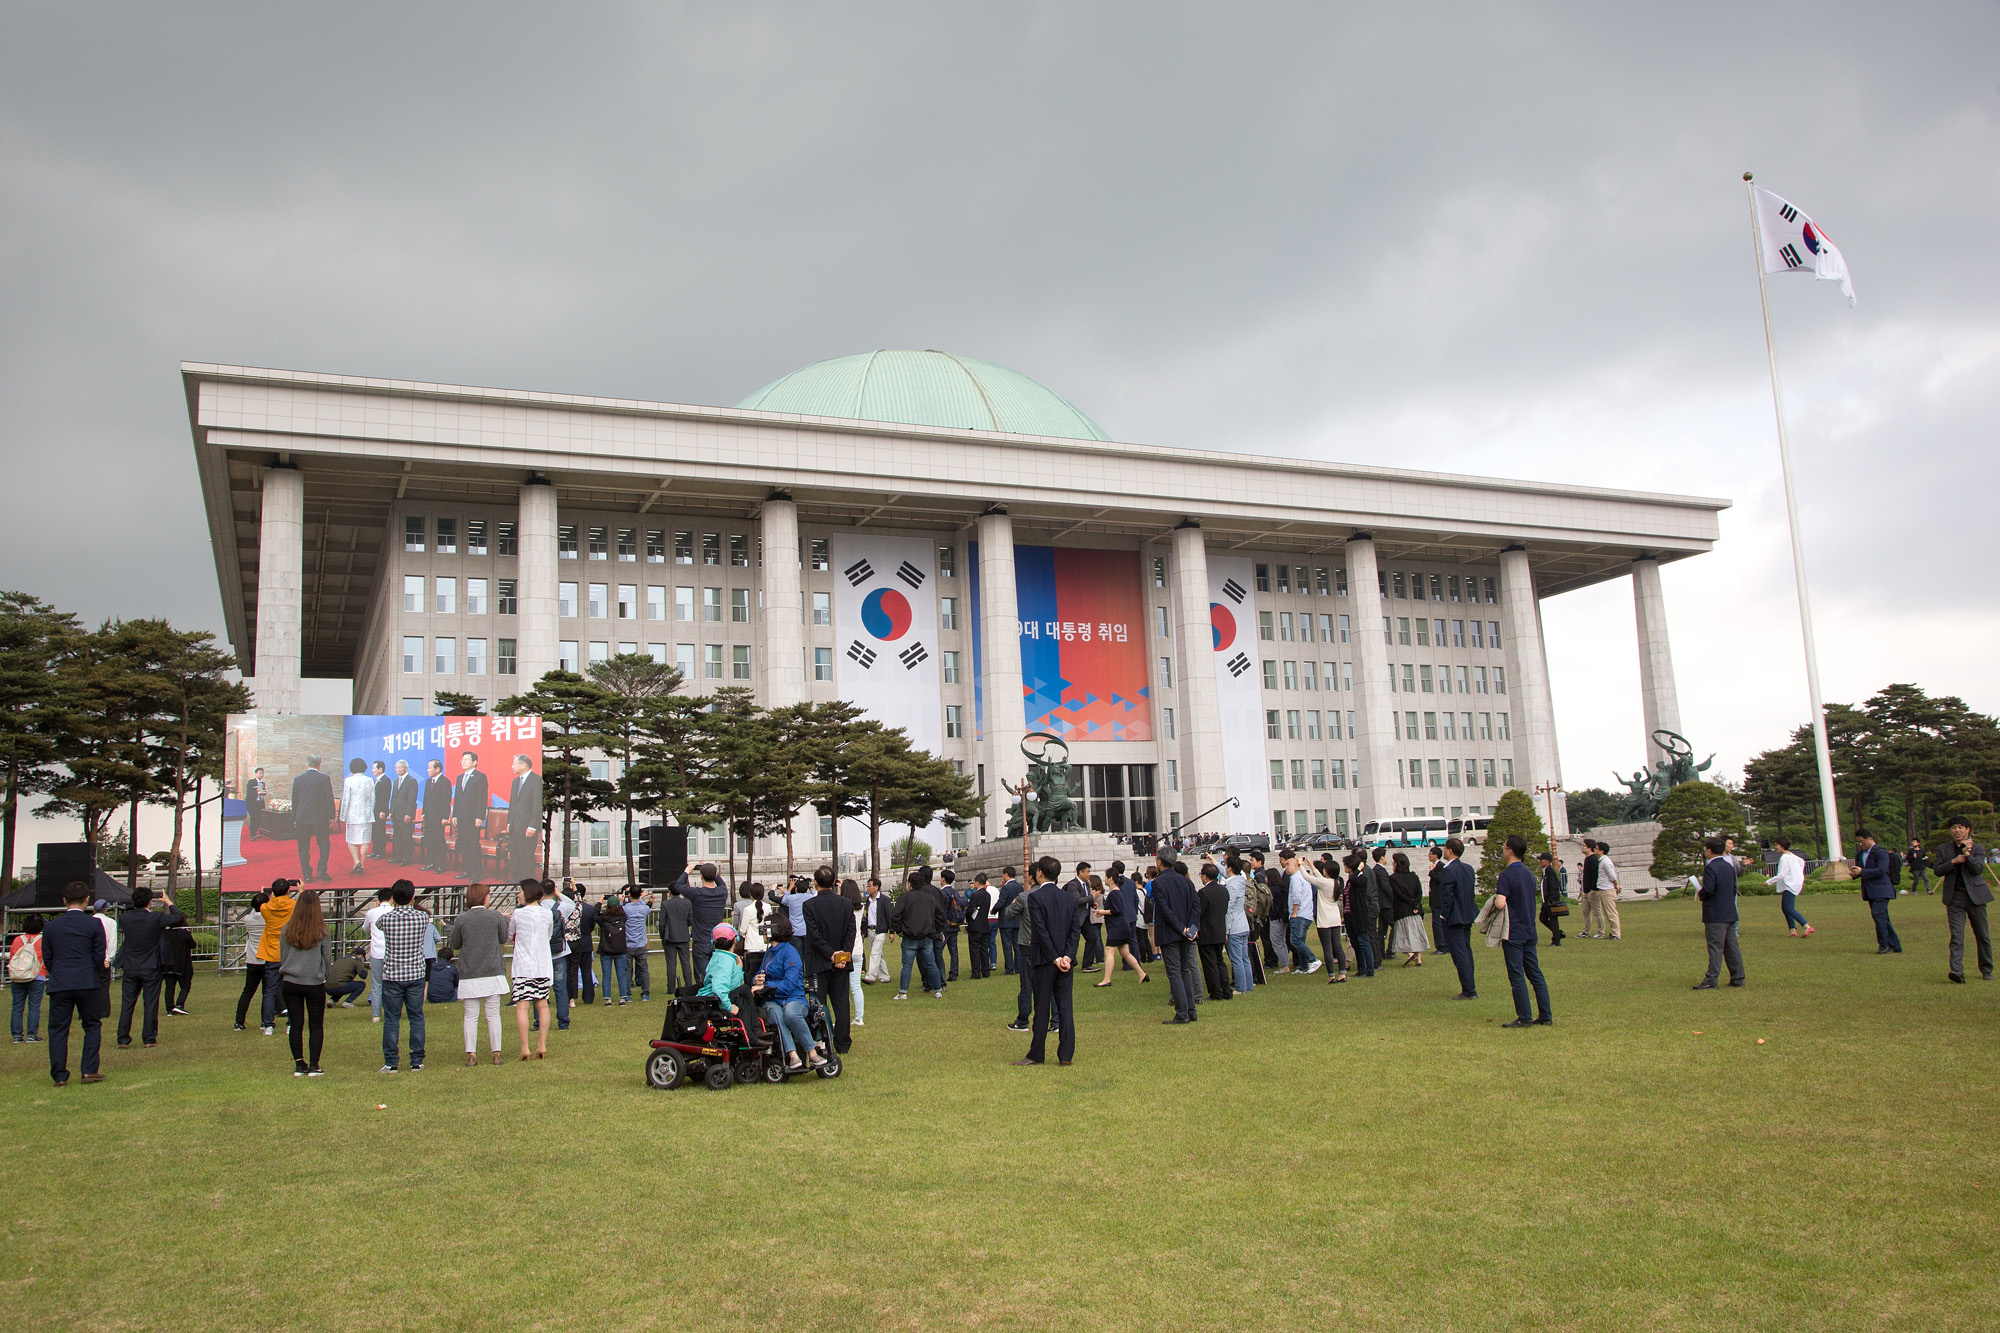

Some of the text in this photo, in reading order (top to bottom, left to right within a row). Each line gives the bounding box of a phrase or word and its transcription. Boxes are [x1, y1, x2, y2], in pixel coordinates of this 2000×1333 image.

[1045, 621, 1092, 642] 대통령
[1098, 623, 1128, 642] 취임
[382, 716, 537, 754] 제19대 대통령 취임
